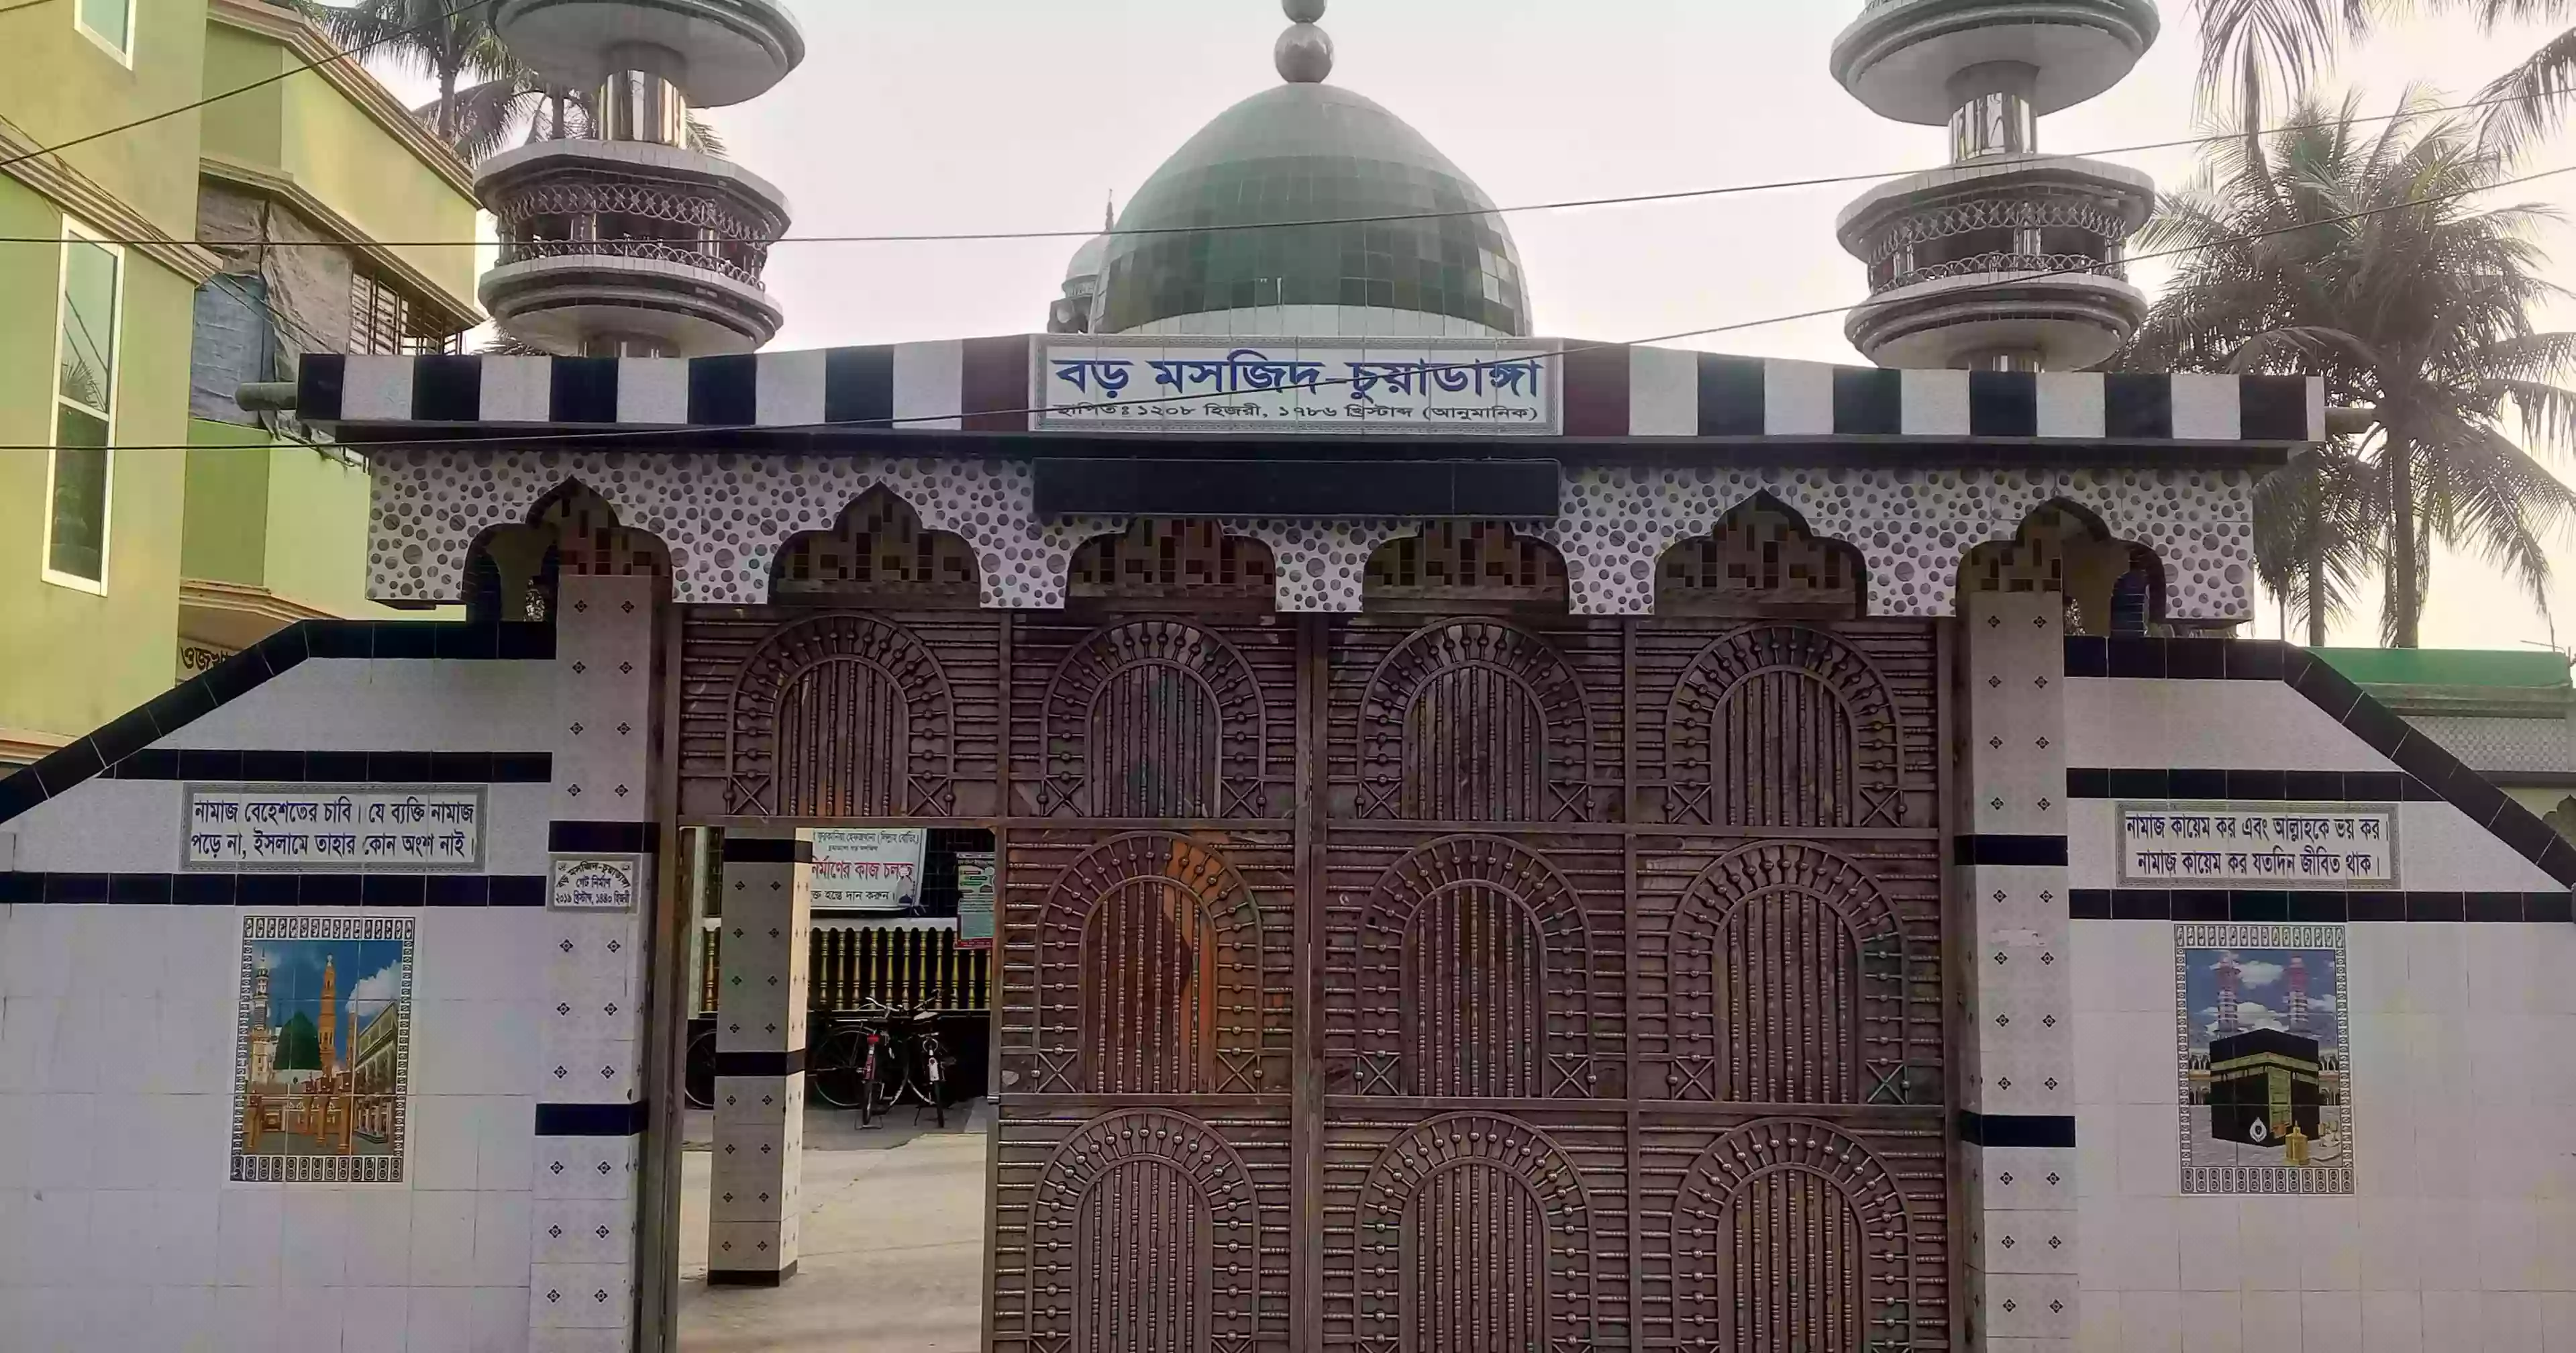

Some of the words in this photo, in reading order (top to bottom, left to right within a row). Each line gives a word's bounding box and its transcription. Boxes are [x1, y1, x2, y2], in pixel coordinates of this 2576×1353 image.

[1049, 358, 1134, 399] বড়
[1137, 405, 1198, 417] ১২০৮
[1205, 403, 1270, 419] হিজরী,
[1278, 405, 1339, 417] ১৭৮৬
[1423, 405, 1539, 421] (আনুমানিক)
[195, 800, 239, 824] নামাজ
[244, 801, 318, 825] বেহেশতের
[368, 803, 385, 824] যে
[391, 796, 426, 825] ব্যক্তি
[431, 801, 475, 825] নামাজ
[191, 832, 222, 859] পড়ে
[226, 831, 247, 859] না,
[252, 827, 310, 856] ইসলামে
[314, 834, 357, 858] তাহার
[362, 835, 396, 856] কোন
[402, 834, 435, 858] অংশ
[2126, 815, 2166, 840] নামাজ
[2169, 815, 2211, 840] কায়েম
[2216, 816, 2236, 840] কর
[2242, 817, 2269, 841] এবং
[2272, 815, 2331, 844] আল্লাহকে
[2334, 818, 2355, 840] ভয়
[855, 862, 880, 881] কাজ
[2136, 848, 2177, 874] নামাজ
[2181, 850, 2222, 874] কায়েম
[2226, 851, 2249, 874] কর
[2252, 844, 2296, 874] যতদিন
[2300, 844, 2341, 875] জীবিত
[845, 891, 863, 902] দান
